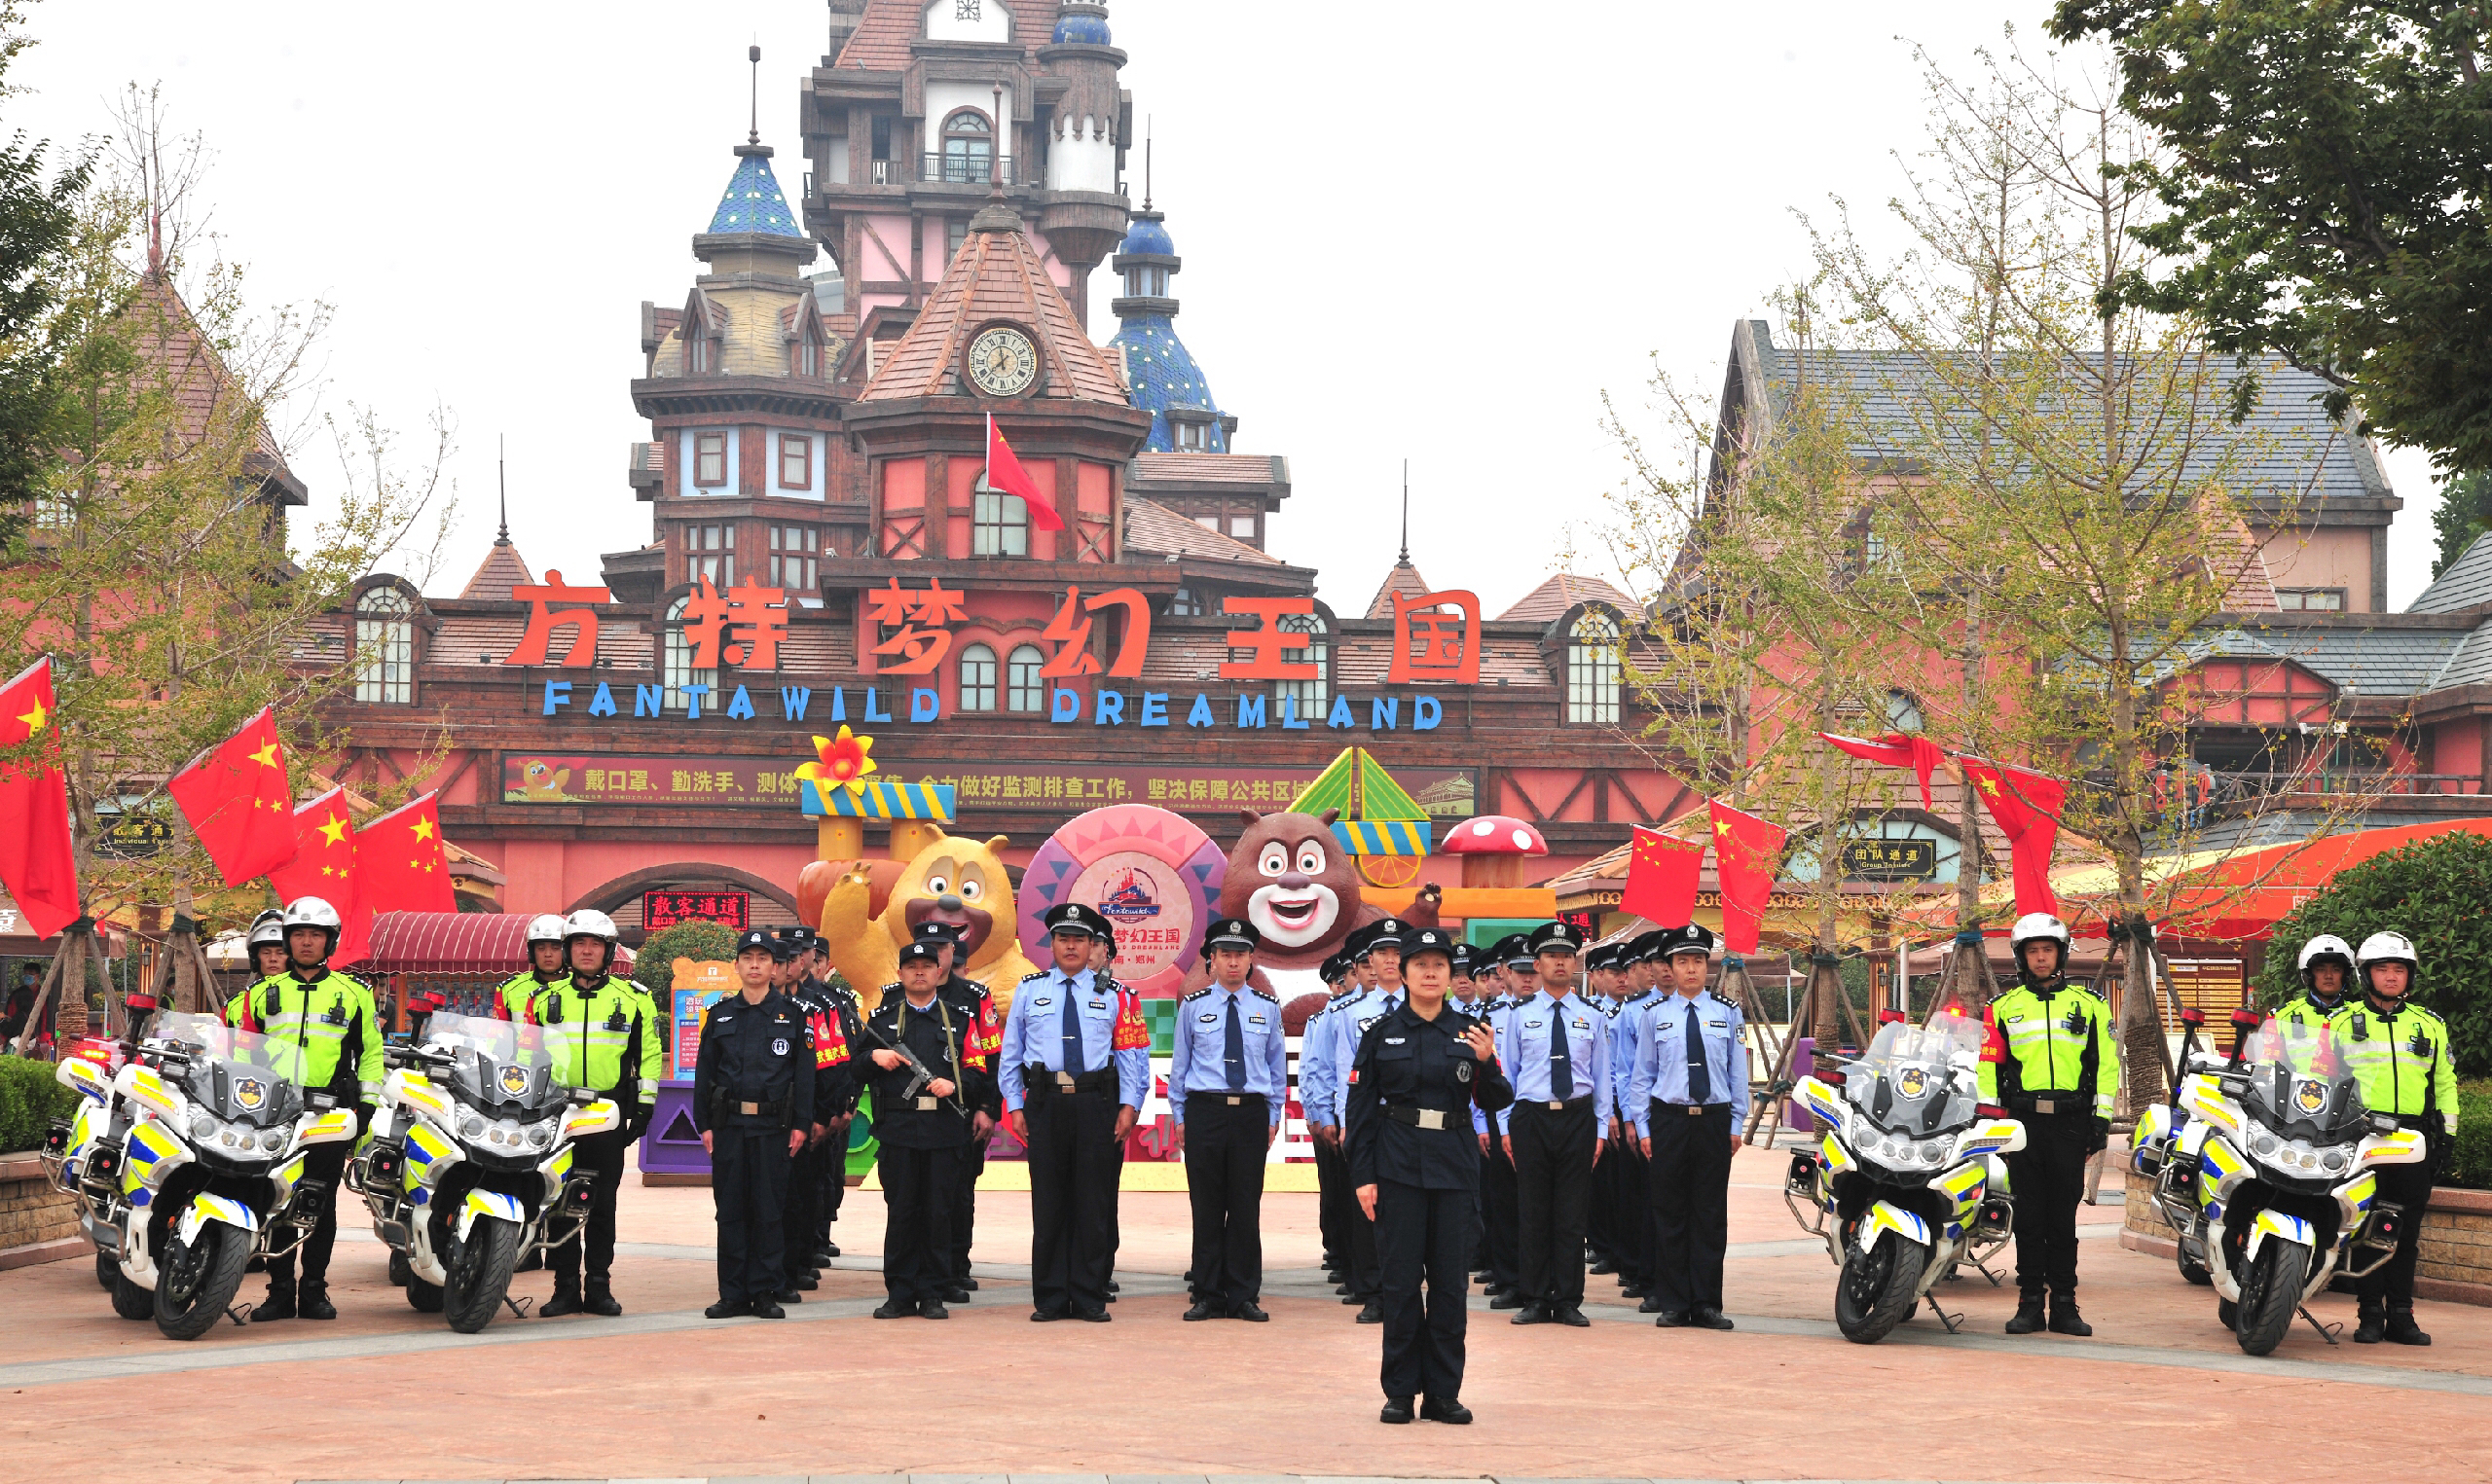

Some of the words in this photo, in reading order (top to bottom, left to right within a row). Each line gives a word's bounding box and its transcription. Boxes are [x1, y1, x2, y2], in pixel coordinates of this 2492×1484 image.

[502, 569, 1481, 684] 方特梦幻王国
[542, 679, 940, 723] FANTAWILD
[1050, 688, 1443, 730] DREAMLAND
[1854, 849, 1918, 861] 团队通道
[652, 895, 741, 917] 散客通道
